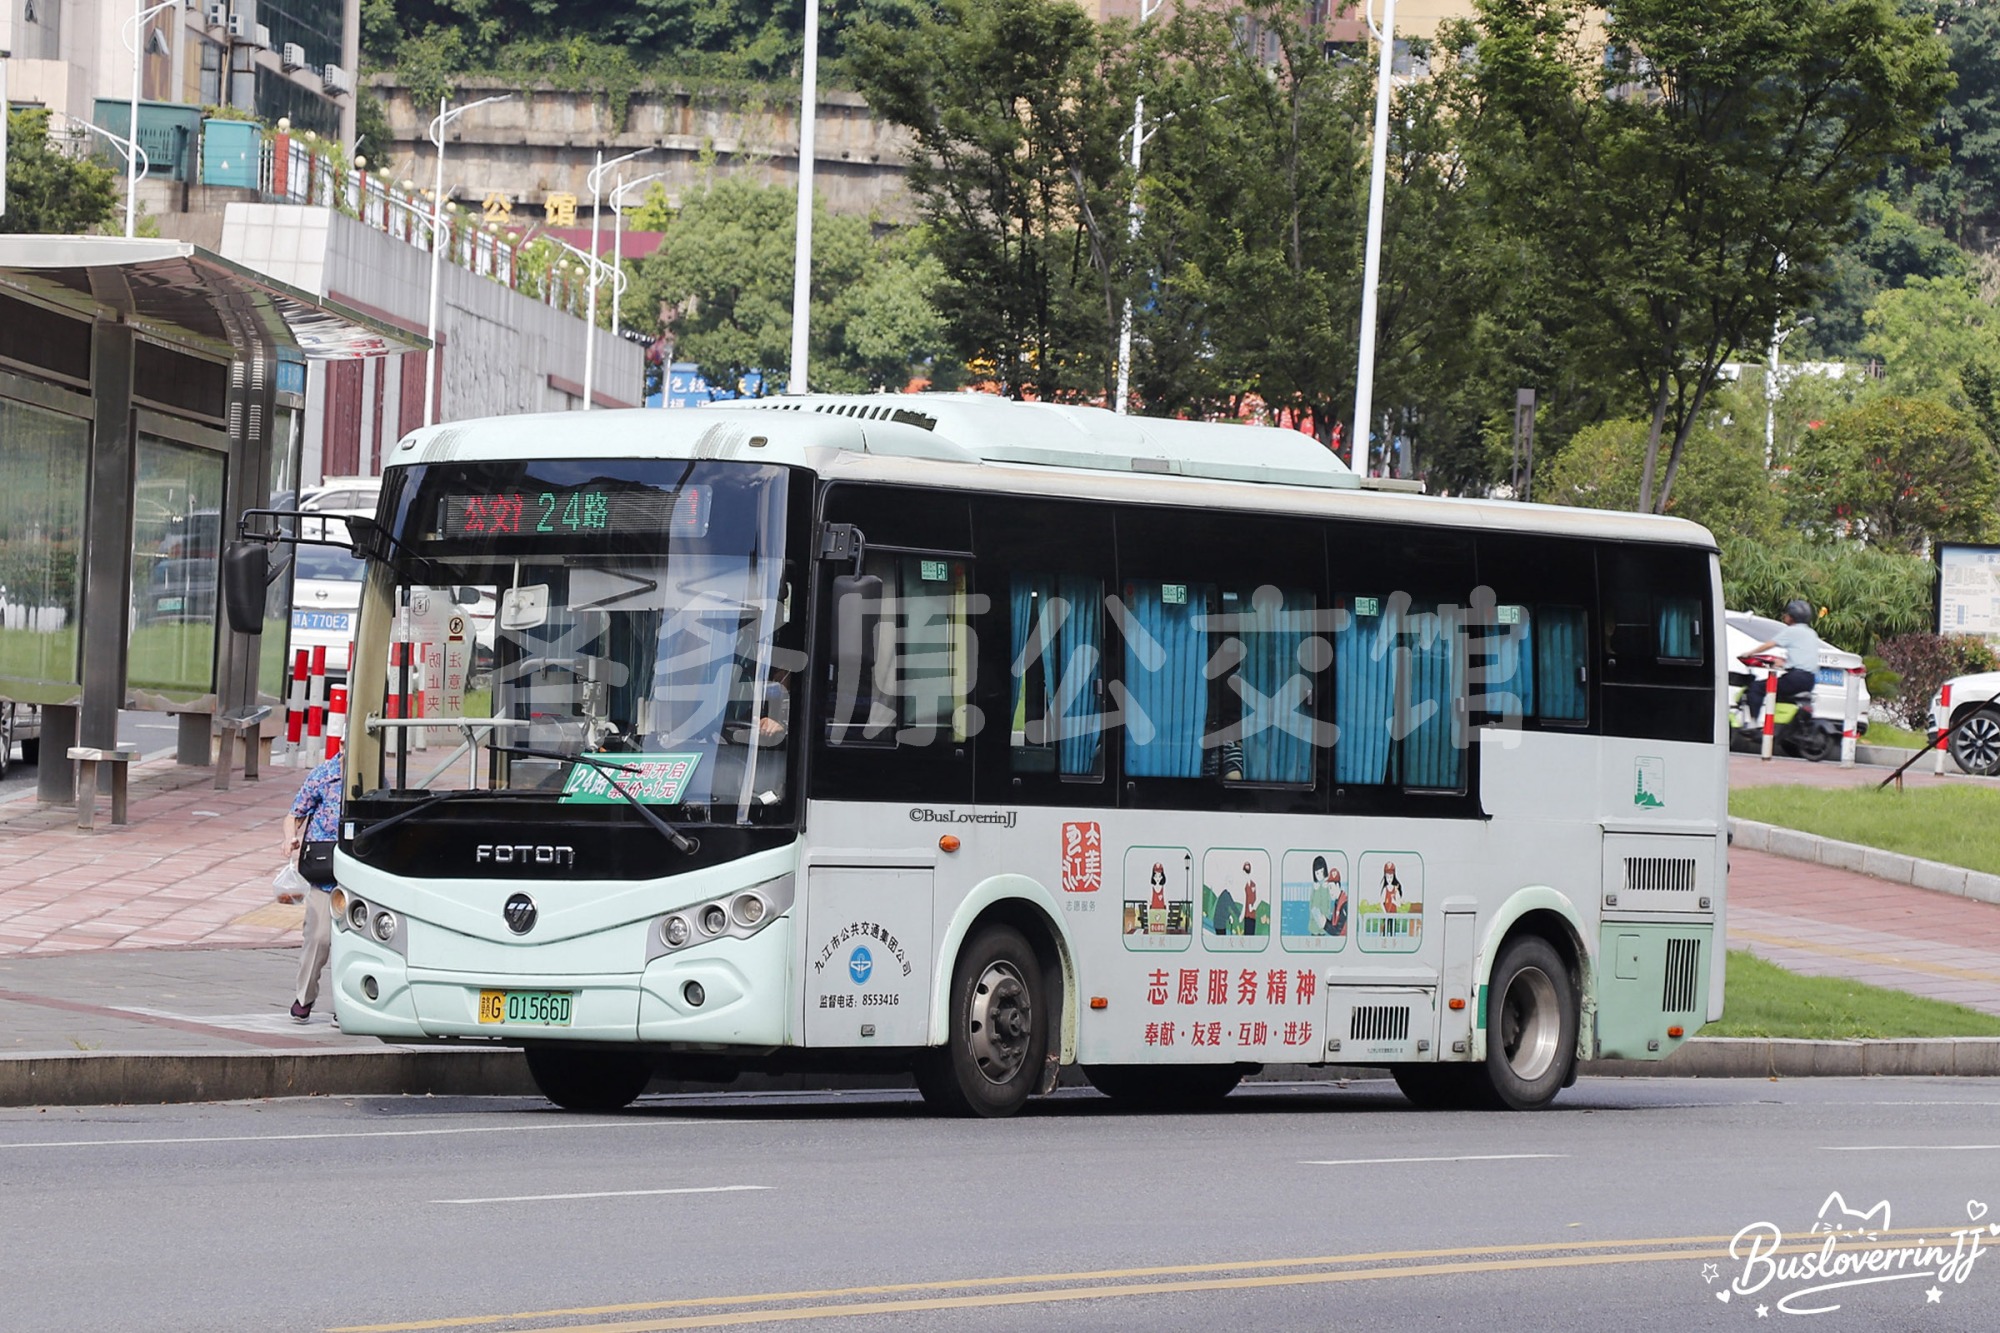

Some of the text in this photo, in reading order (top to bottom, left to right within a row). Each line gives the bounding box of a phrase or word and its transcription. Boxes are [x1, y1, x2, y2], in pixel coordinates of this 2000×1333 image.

[536, 491, 608, 532] 24路
[617, 762, 688, 780] 空调开启
[476, 845, 574, 864] FOTON
[814, 921, 912, 977] 九江市公共交通集团公司
[1147, 968, 1316, 1005] 志愿服务精神
